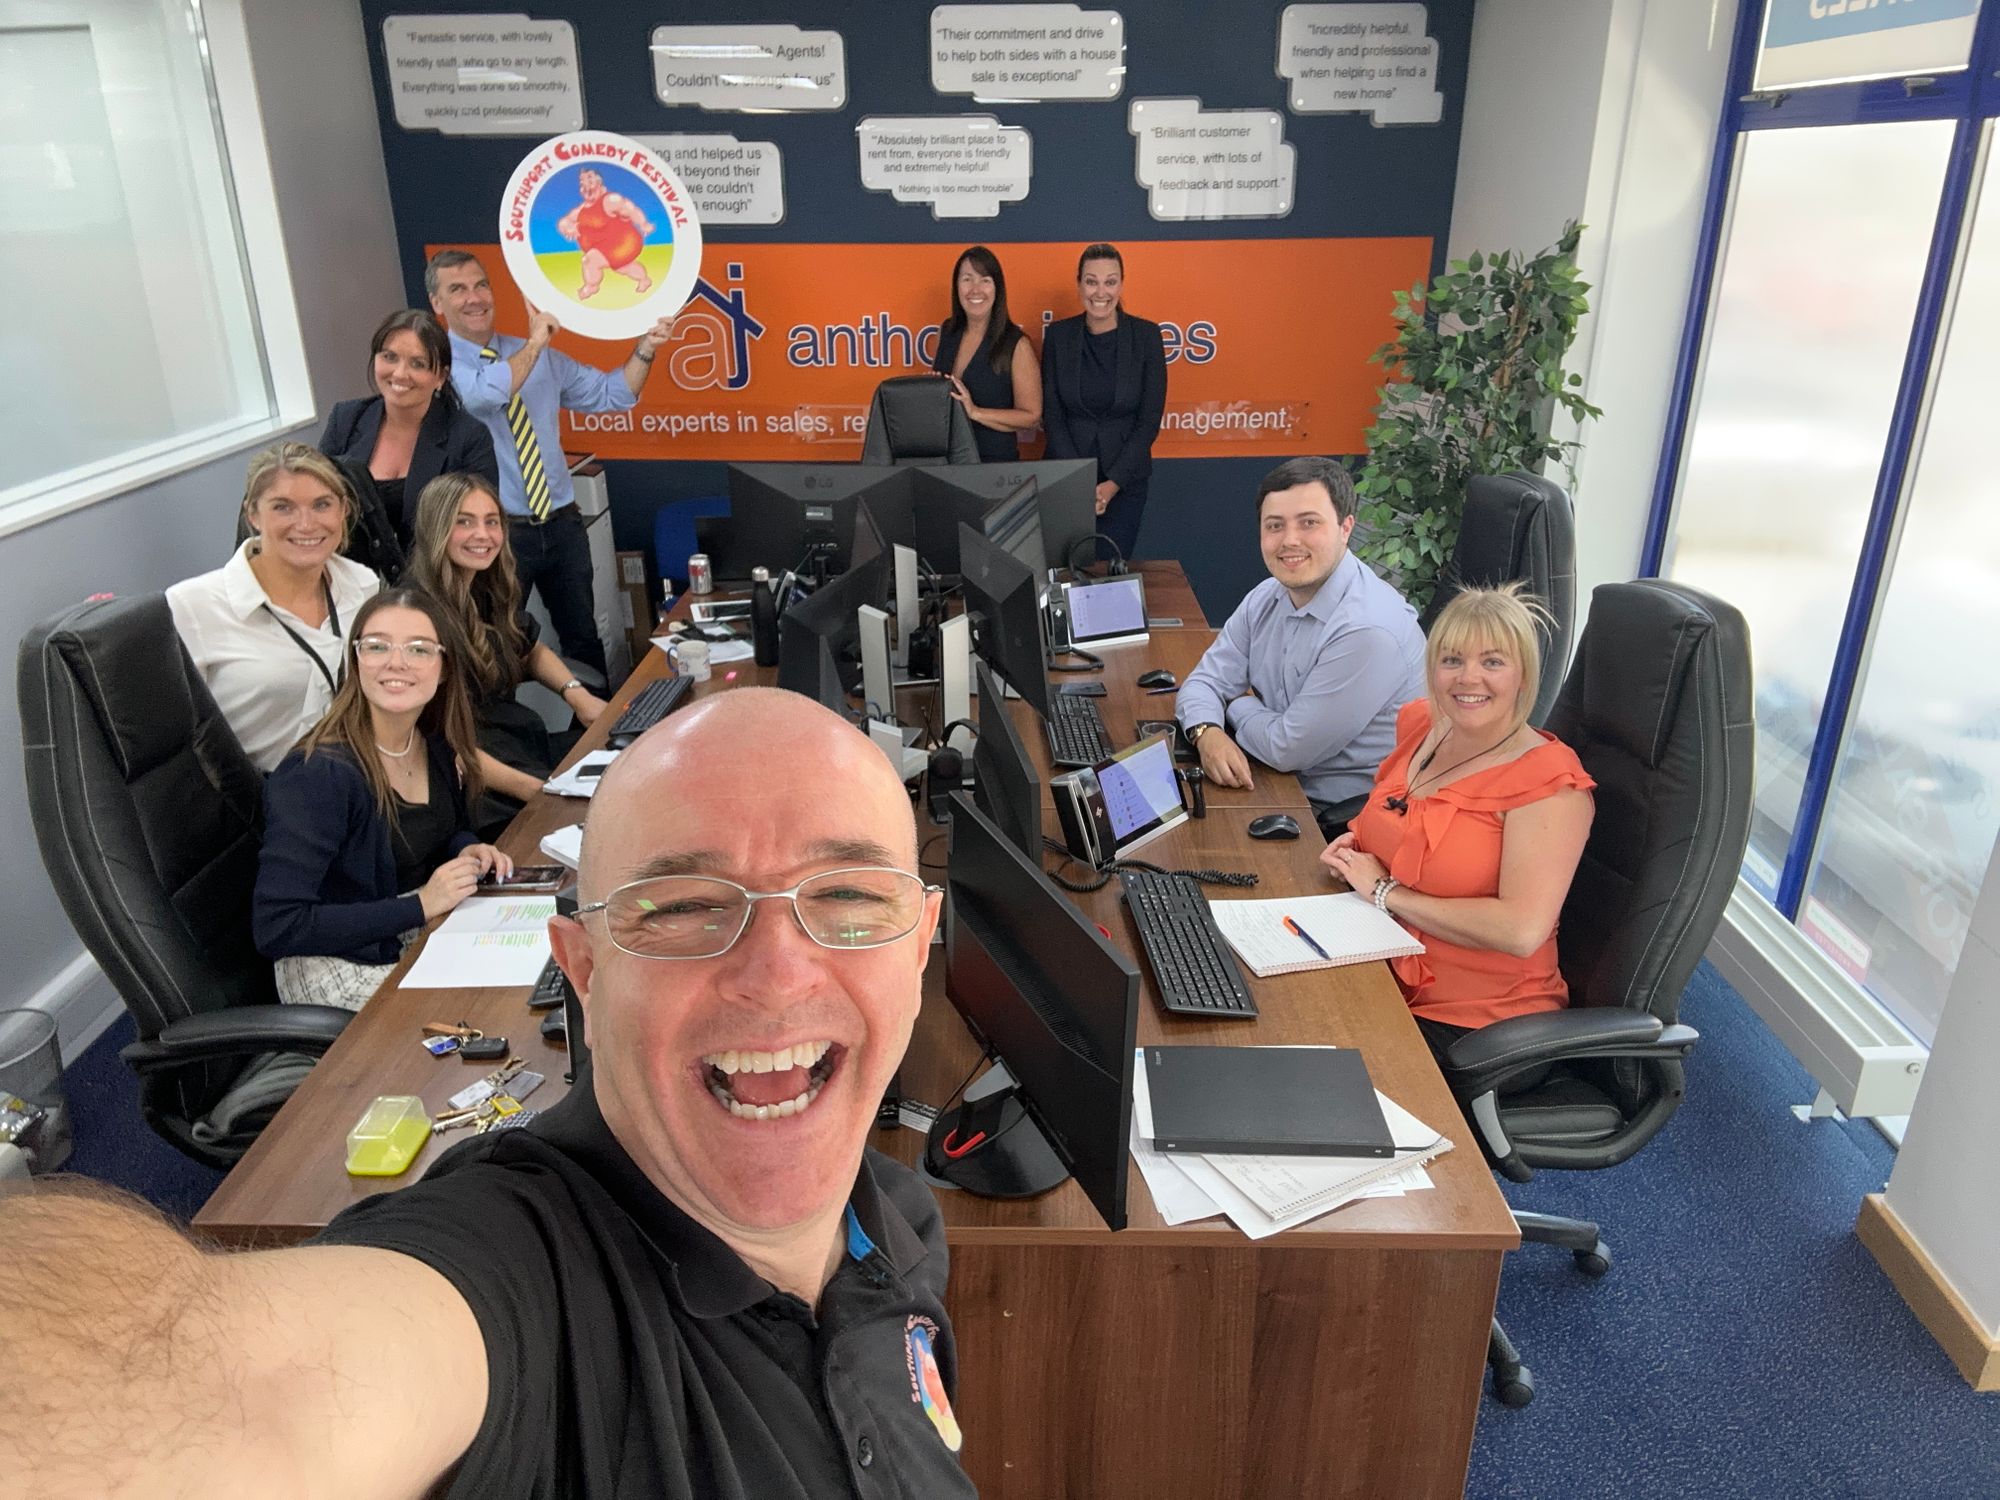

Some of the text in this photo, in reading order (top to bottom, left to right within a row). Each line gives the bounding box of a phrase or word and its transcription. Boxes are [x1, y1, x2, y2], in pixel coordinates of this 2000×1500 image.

[523, 31, 552, 43] lovely
[974, 28, 1046, 40] commitment
[1049, 28, 1071, 39] and
[1075, 27, 1104, 39] drive
[776, 44, 825, 61] Agents!
[937, 48, 1116, 64] to help both sides with a house
[1292, 44, 1431, 59] friendly and professional
[463, 57, 485, 67] who
[486, 60, 500, 69] go
[501, 58, 512, 67] to
[514, 59, 533, 69] any
[971, 71, 996, 82] sale
[999, 71, 1009, 82] is
[1300, 66, 1427, 80] when helping us find a
[665, 73, 719, 87] Couldn't
[402, 81, 455, 94] Everything
[457, 83, 478, 91] was
[480, 82, 505, 91] done
[508, 82, 521, 91] so
[1333, 88, 1357, 99] new
[425, 106, 459, 118] quickly
[1199, 127, 1251, 138] customer
[930, 134, 965, 145] brilliant
[968, 134, 995, 147] place
[997, 134, 1007, 145] to
[674, 147, 698, 160] and
[701, 146, 743, 162] helped
[746, 149, 762, 160] us
[868, 150, 887, 159] rent
[916, 150, 961, 161] everyone
[964, 149, 973, 158] is
[975, 148, 1011, 160] friendly
[1202, 152, 1225, 163] with
[1228, 152, 1248, 163] lots
[1250, 151, 1262, 163] of
[684, 165, 731, 180] beyond
[733, 164, 761, 177] their
[883, 162, 902, 173] and
[904, 161, 952, 174] extremely
[686, 182, 755, 194] we couldn't
[932, 185, 940, 194] is
[941, 184, 956, 194] too
[957, 184, 981, 194] much
[1159, 179, 1209, 190] feedback
[1212, 178, 1233, 190] and
[786, 312, 938, 368] antho
[569, 410, 633, 431] Local
[640, 411, 730, 437] experts
[737, 410, 757, 430] in
[765, 410, 834, 434] sales,
[1161, 407, 1292, 435] nagement.
